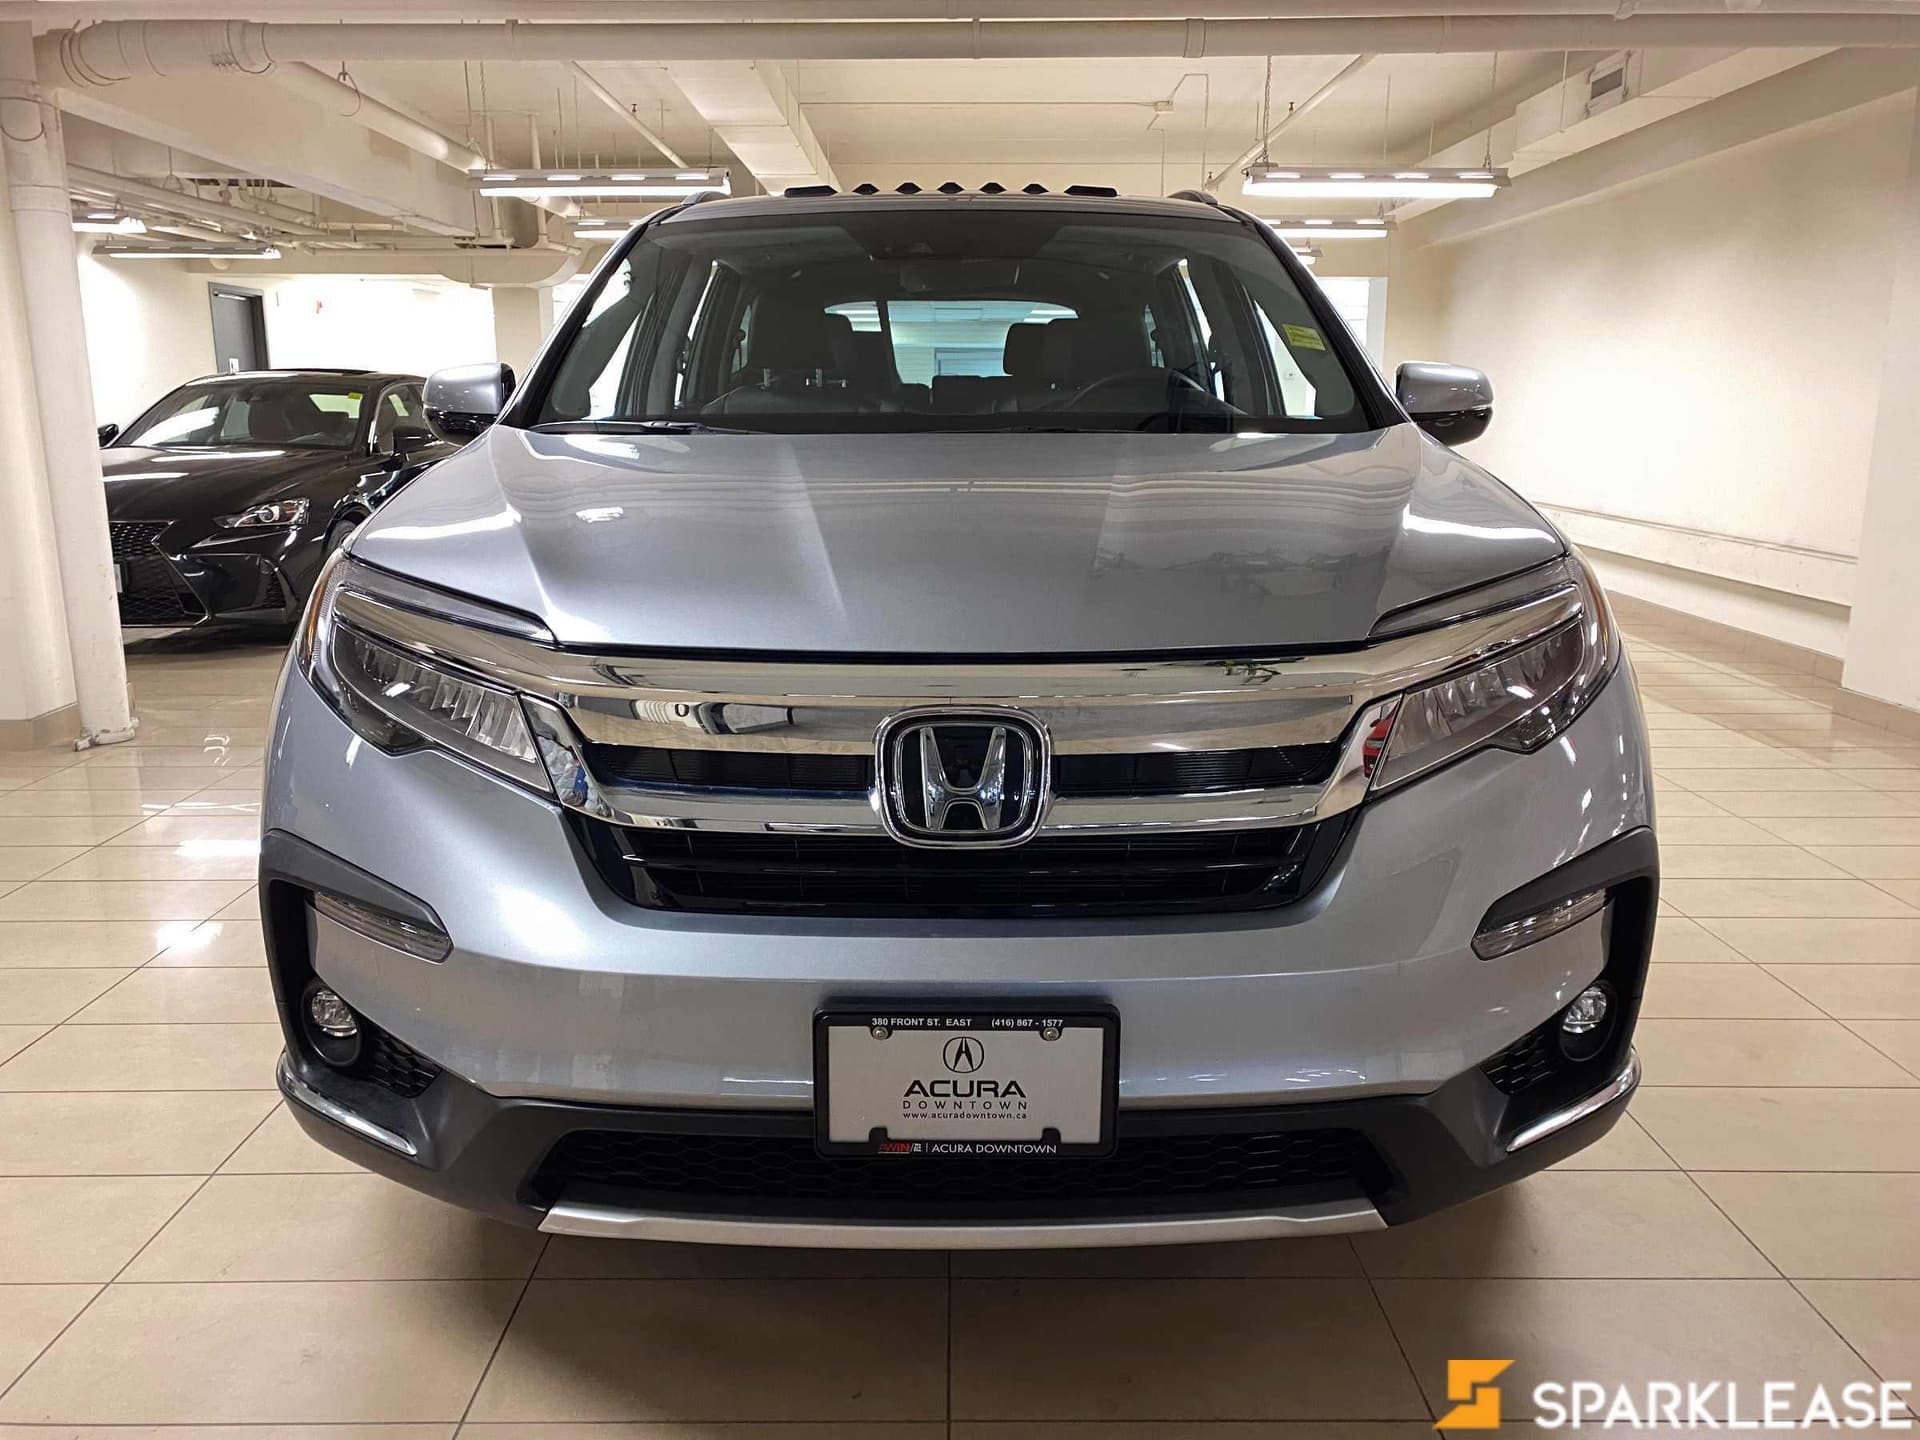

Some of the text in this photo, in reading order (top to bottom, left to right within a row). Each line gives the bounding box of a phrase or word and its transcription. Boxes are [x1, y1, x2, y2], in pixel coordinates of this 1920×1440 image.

[872, 1018, 972, 1026] 380 FRONT ST. EAST
[992, 1018, 1014, 1028] (416)
[1042, 1019, 1063, 1027] 1577
[903, 1079, 1027, 1098] ACURA
[903, 1100, 1027, 1110] DOWNTOWN
[903, 1111, 1027, 1120] www.acuradowntown.ca
[931, 1143, 973, 1153] ACURA
[975, 1144, 1057, 1154] DOWNTOWN
